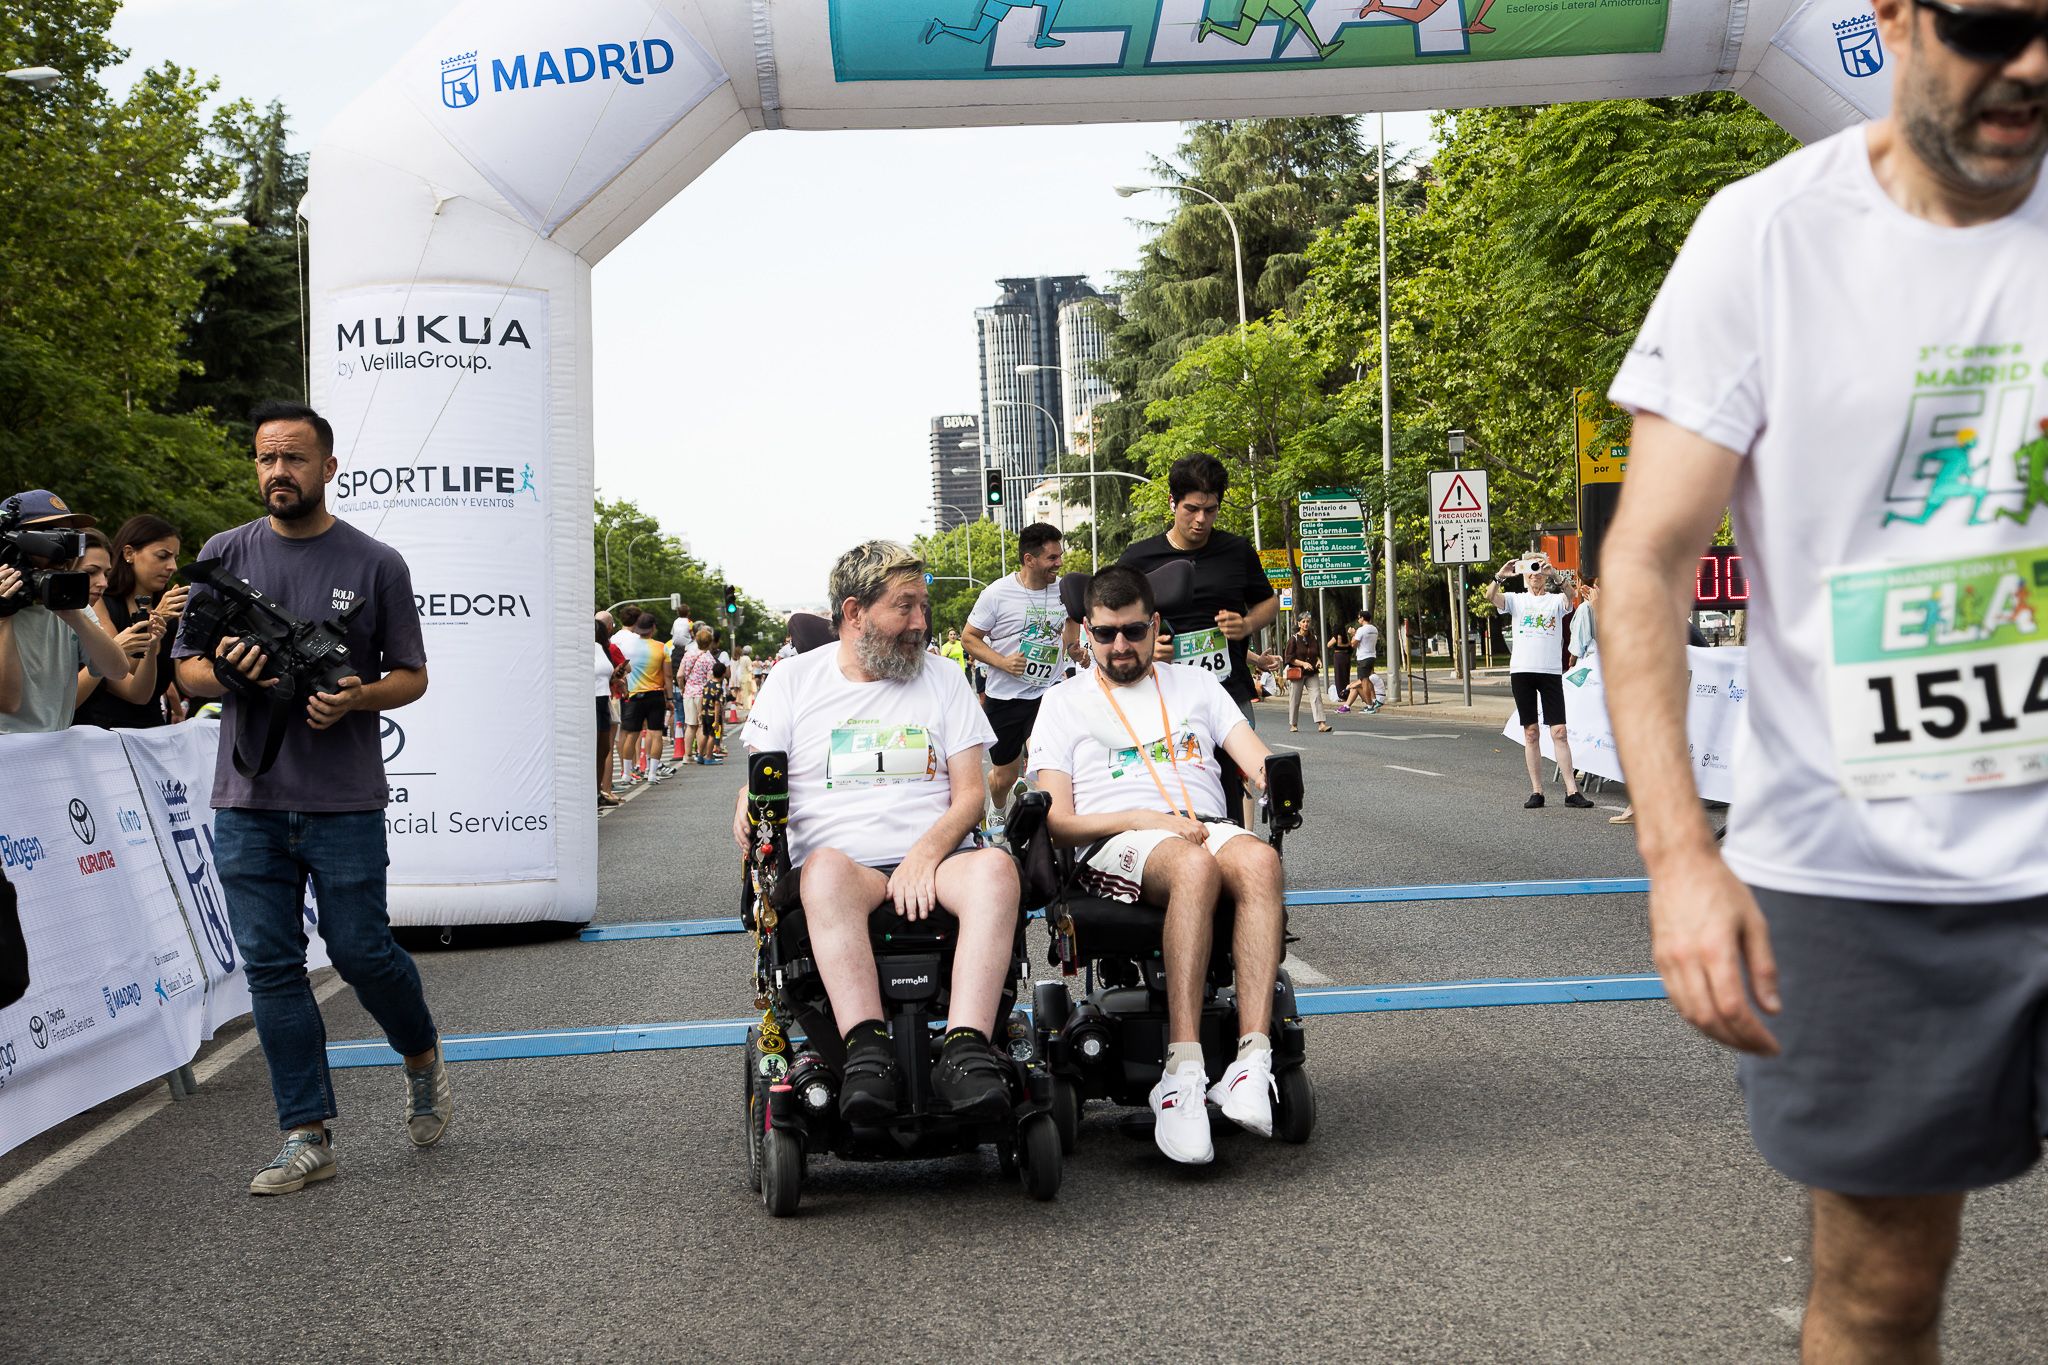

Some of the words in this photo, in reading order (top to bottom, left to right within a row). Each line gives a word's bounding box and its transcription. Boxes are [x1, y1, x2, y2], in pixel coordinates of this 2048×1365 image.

[1506, 4, 1558, 14] Esclerosis
[1561, 0, 1597, 10] Lateral
[491, 38, 675, 92] MADRID
[337, 315, 532, 351] MUKUA
[338, 360, 356, 380] by
[361, 351, 492, 374] VelillaGroup.
[1914, 362, 2033, 387] MADRID
[943, 416, 976, 428] BBVA
[1593, 466, 1610, 474] por
[337, 466, 515, 499] SPORTLIFE
[383, 496, 458, 509] COMUNICACIÓN
[461, 498, 467, 507] Y
[470, 498, 515, 508] EVENTOS
[1438, 511, 1482, 519] PRECAUCIÓN
[332, 588, 355, 600] BOLD
[1180, 635, 1215, 656] ELA
[1026, 662, 1052, 678] 072
[875, 751, 885, 773] 1
[449, 810, 548, 834] Services
[891, 974, 929, 987] permobil
[112, 982, 142, 1010] MADRID
